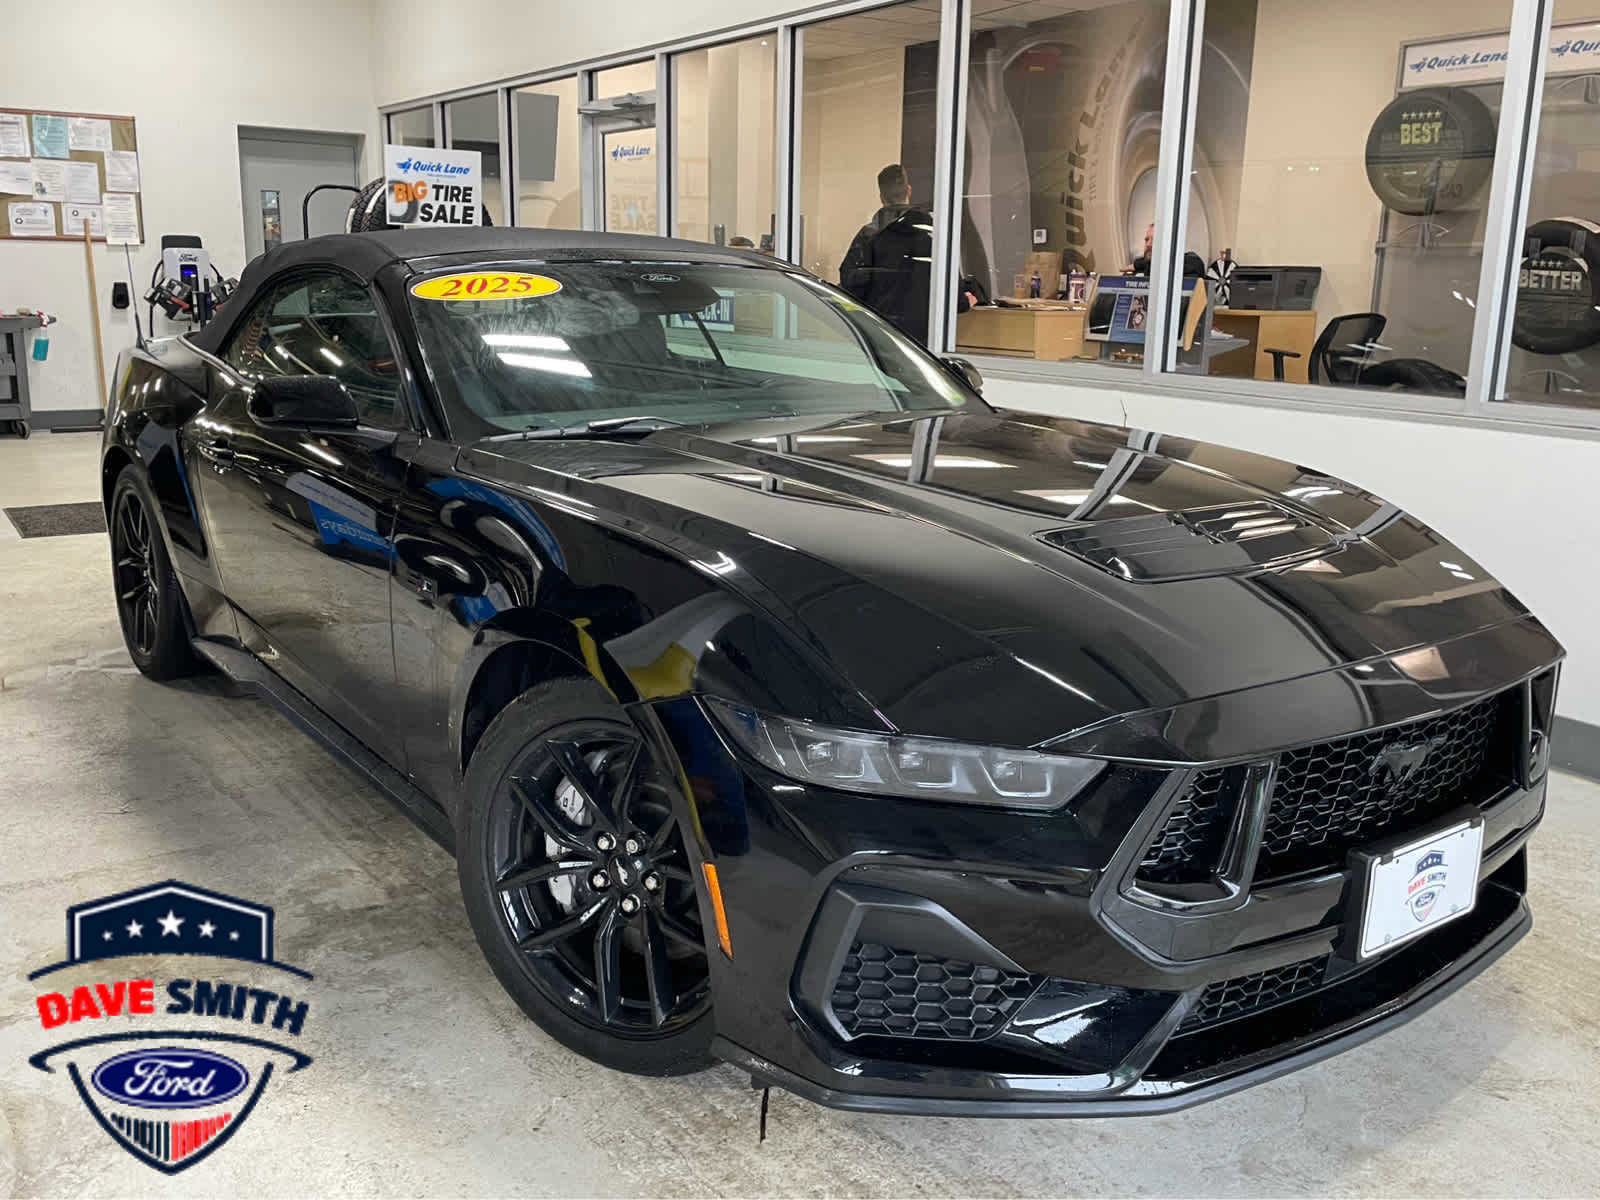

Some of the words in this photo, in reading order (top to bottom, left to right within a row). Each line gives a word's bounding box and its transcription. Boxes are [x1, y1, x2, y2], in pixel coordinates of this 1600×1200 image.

[1427, 54, 1470, 69] Quick
[1400, 121, 1443, 145] BEST
[412, 160, 442, 173] Quick
[443, 163, 470, 175] Lane
[393, 180, 428, 203] BIG
[431, 183, 473, 203] TIRE
[419, 202, 474, 225] SALE
[1061, 137, 1096, 275] Quick
[440, 276, 534, 297] 2025
[1518, 268, 1582, 290] BETTER
